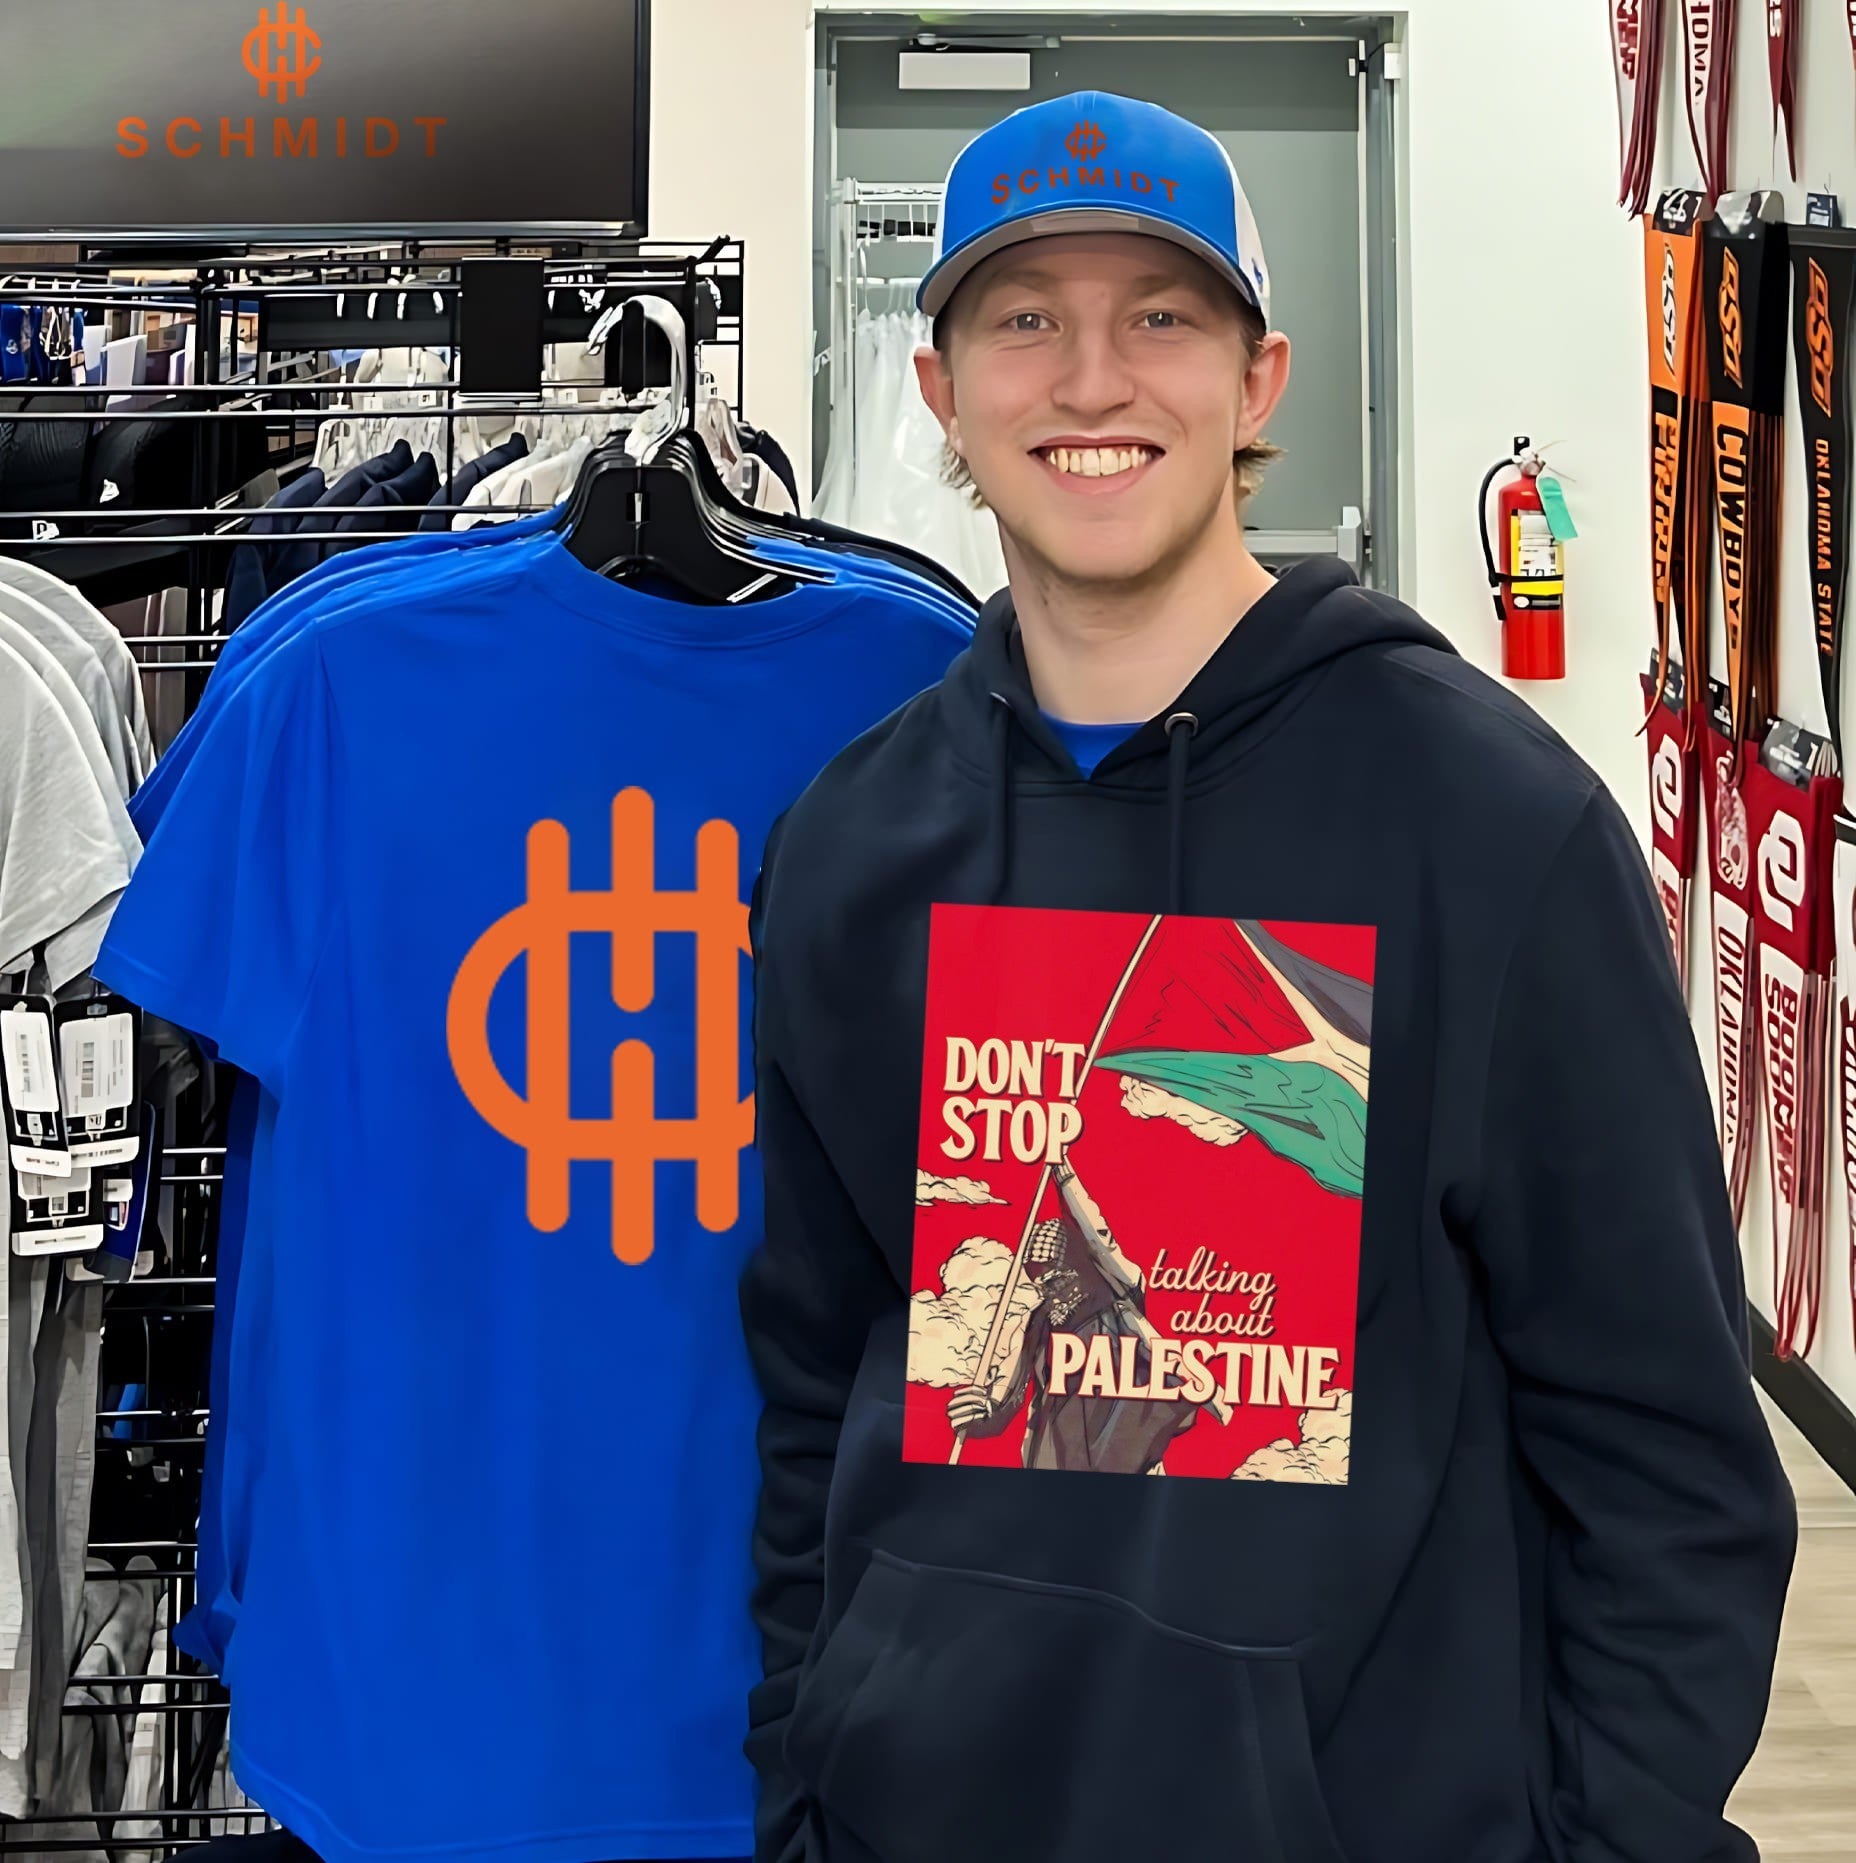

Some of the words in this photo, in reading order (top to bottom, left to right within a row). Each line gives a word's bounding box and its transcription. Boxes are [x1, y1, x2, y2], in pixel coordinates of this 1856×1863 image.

[115, 116, 448, 159] SCHMIDT
[991, 167, 1180, 205] SCHMIDT
[1815, 438, 1832, 571] OKLAHOMA
[1816, 582, 1834, 657] STATE
[944, 1036, 1087, 1099] DON'T
[940, 1097, 1083, 1165] STOP
[1149, 1246, 1278, 1309] talking
[1170, 1292, 1275, 1337] about
[1048, 1332, 1340, 1411] PALESTINE
